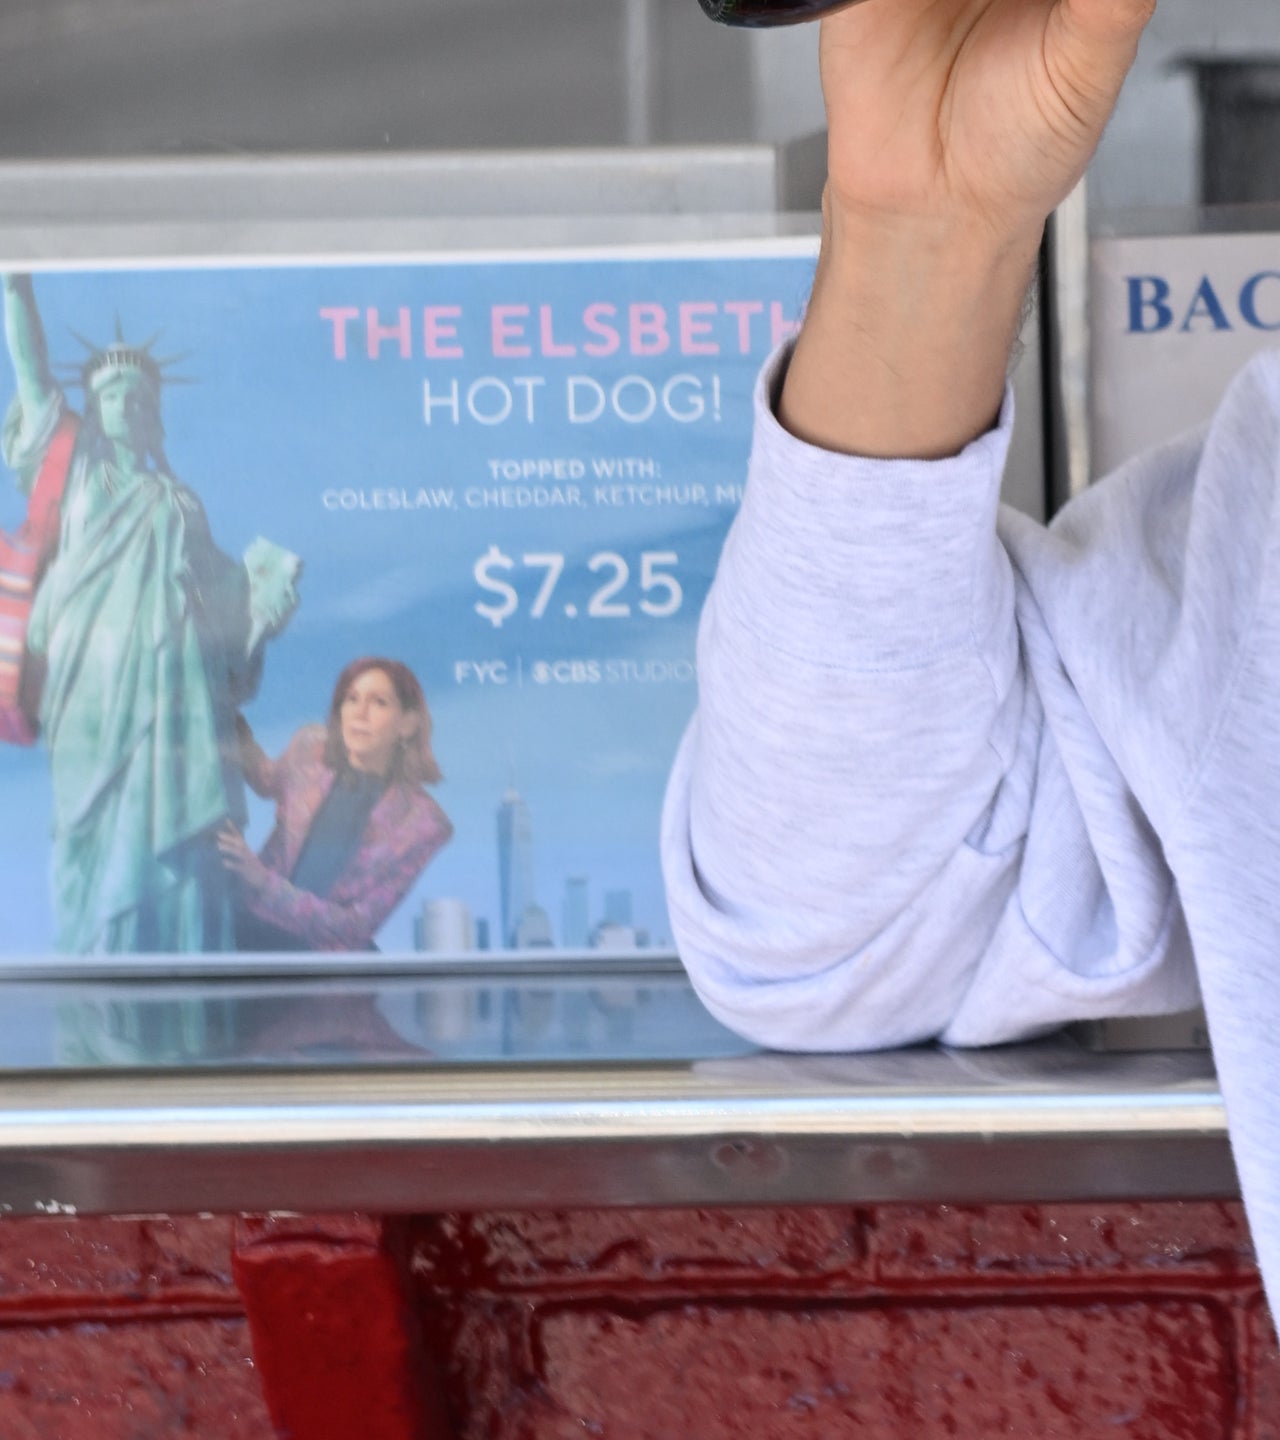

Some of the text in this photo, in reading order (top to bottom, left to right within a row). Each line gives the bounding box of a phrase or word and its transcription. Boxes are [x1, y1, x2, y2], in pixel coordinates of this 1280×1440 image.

[319, 304, 464, 360] THE
[422, 373, 723, 425] HOT DOG!
[488, 457, 662, 480] TOPPED WITH:
[322, 487, 458, 511] COLESLAW,
[465, 484, 588, 508] CHEDDAR,
[595, 483, 710, 507] KETCHUP,
[473, 544, 683, 628] $7.25
[454, 660, 507, 685] FYC
[606, 658, 697, 683] STUDIO
